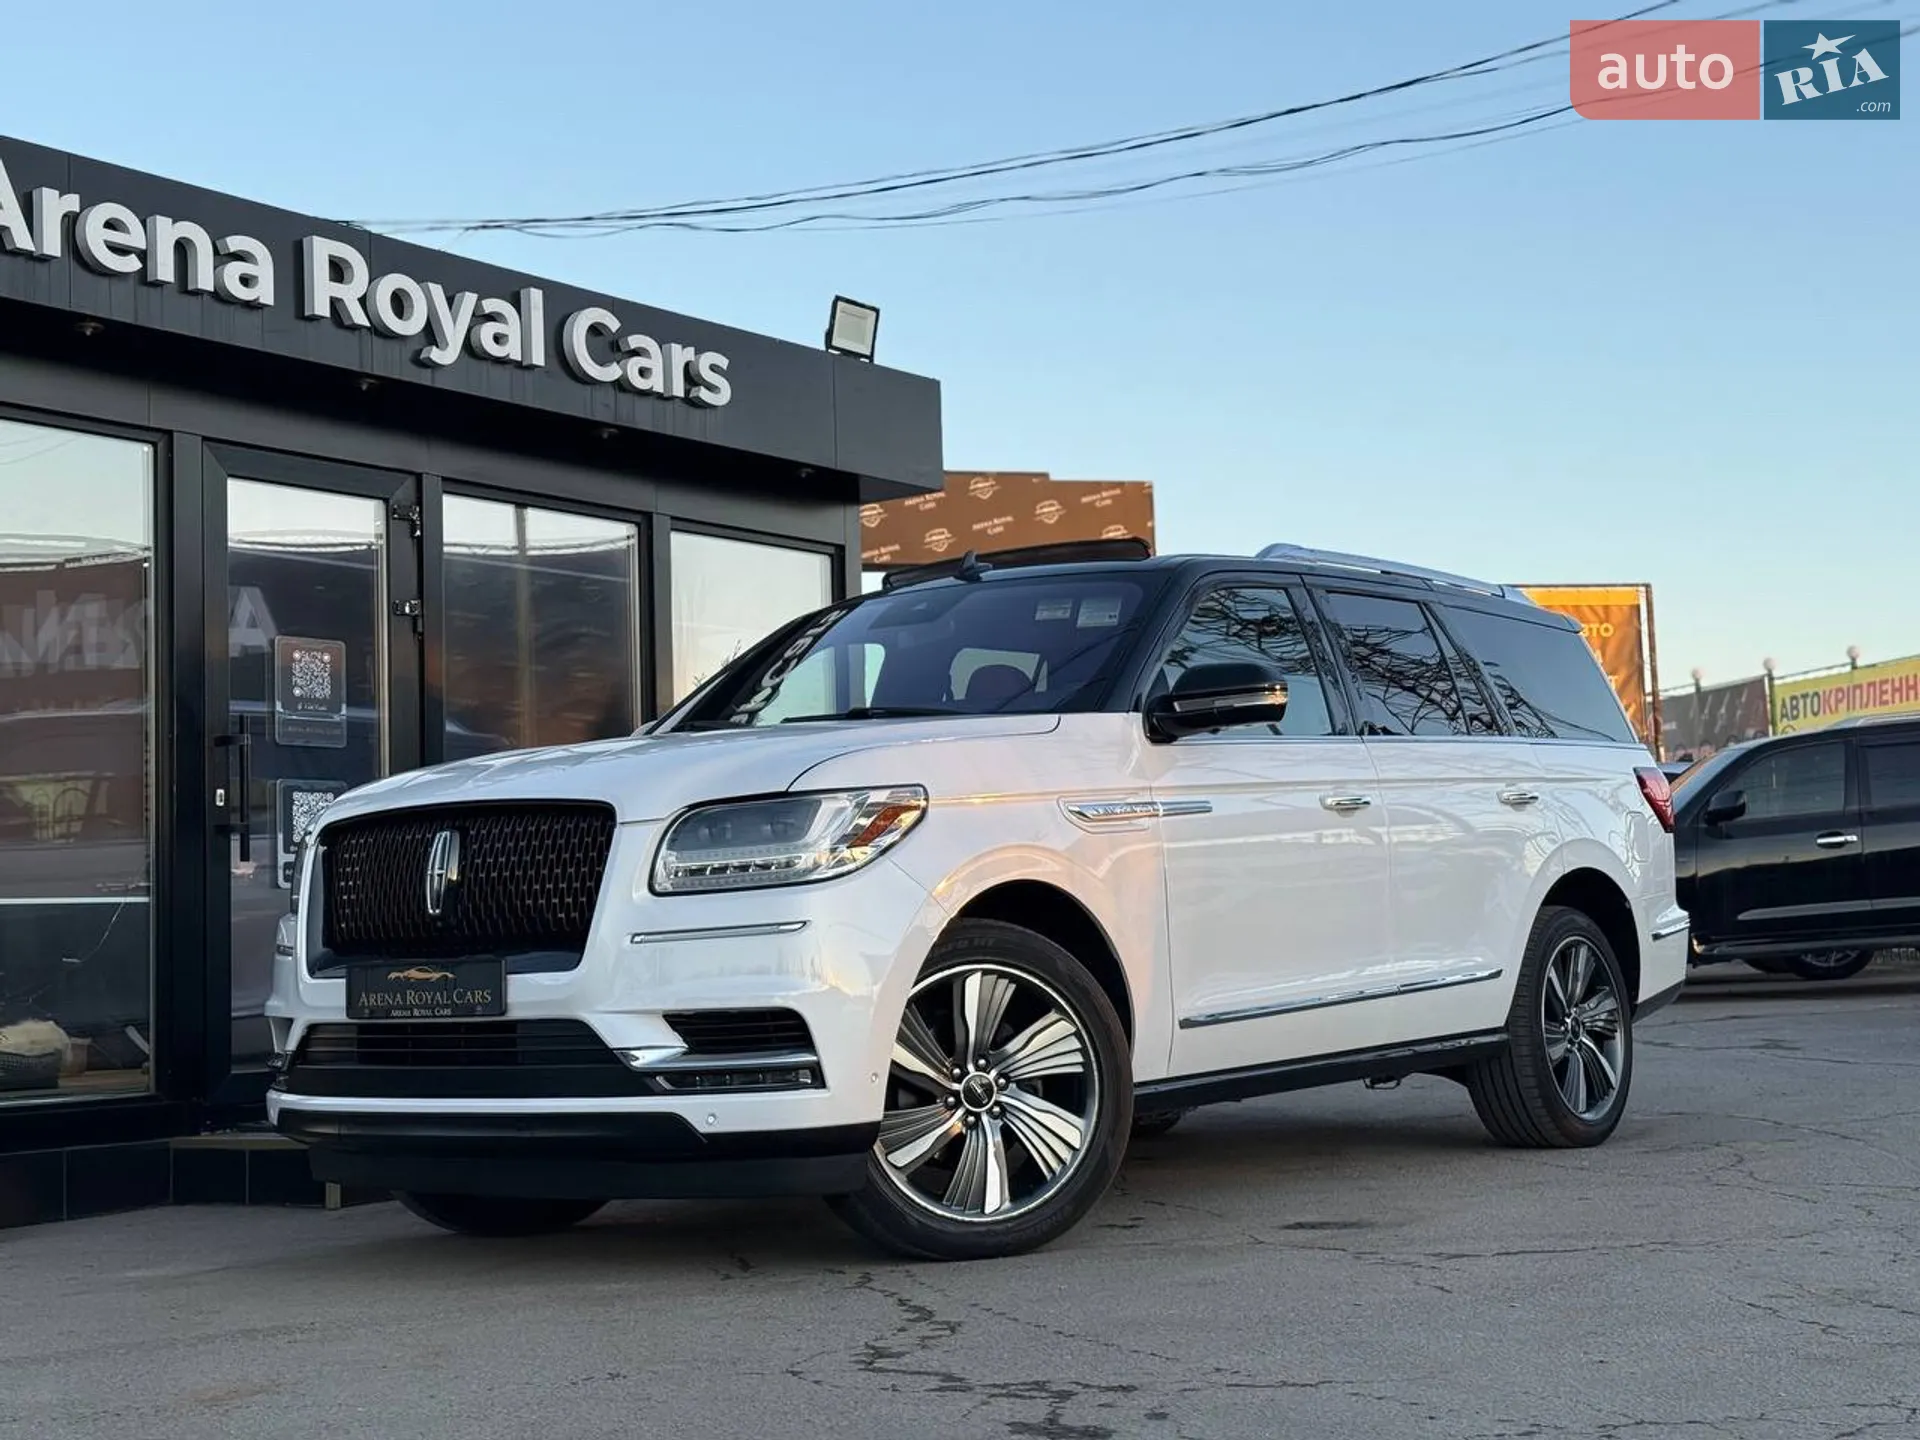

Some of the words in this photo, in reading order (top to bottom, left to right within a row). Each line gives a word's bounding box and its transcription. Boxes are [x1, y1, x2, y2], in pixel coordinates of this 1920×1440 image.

[302, 235, 545, 367] Royal
[563, 307, 732, 408] Cars
[1779, 672, 1920, 722] АВТОКРІПЛЕНН
[359, 991, 402, 1007] ARENA
[406, 989, 452, 1005] ROYAL
[453, 988, 492, 1004] CARS
